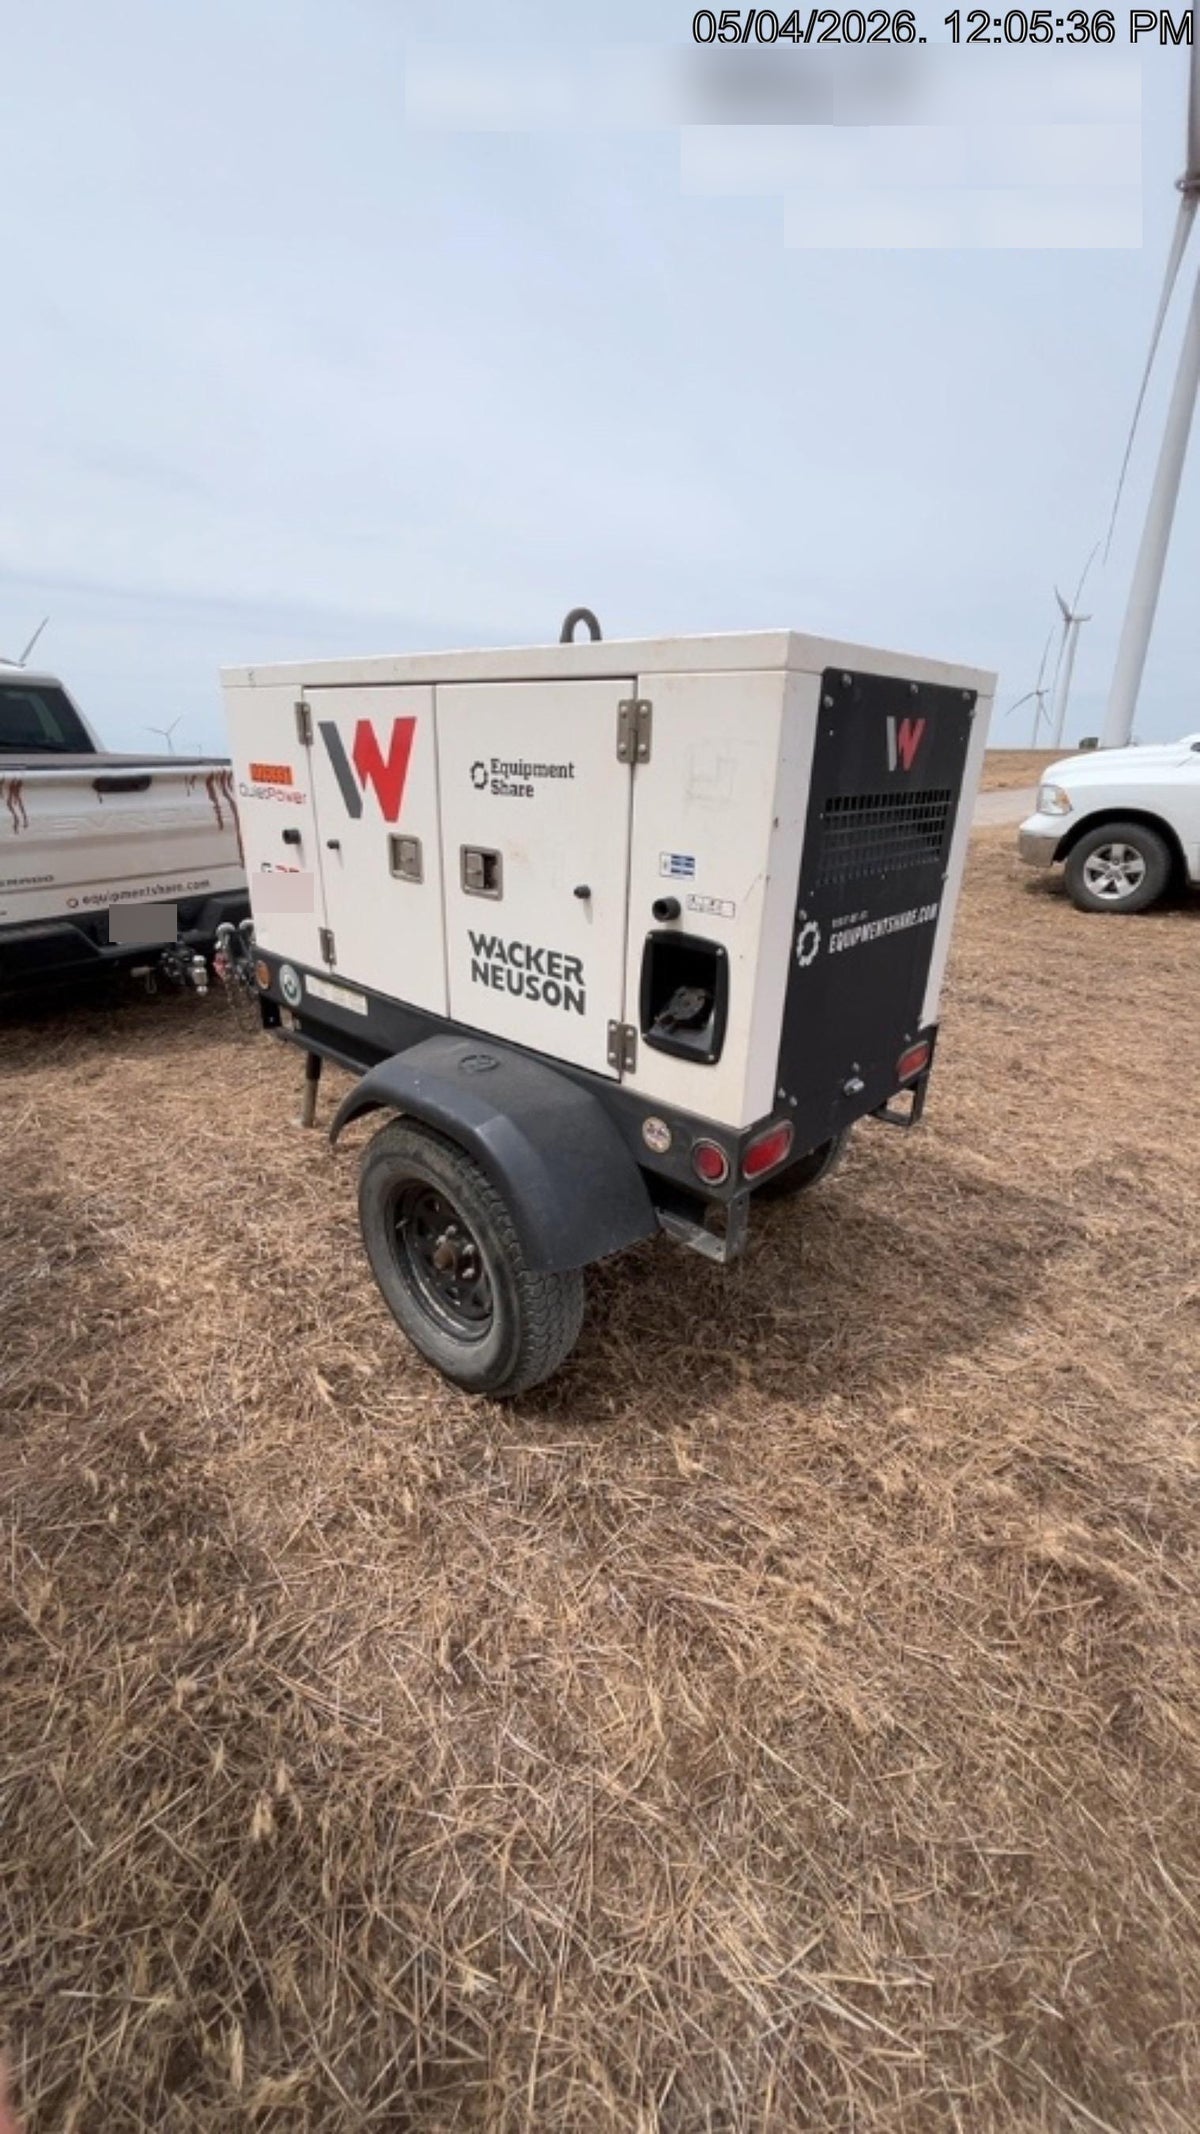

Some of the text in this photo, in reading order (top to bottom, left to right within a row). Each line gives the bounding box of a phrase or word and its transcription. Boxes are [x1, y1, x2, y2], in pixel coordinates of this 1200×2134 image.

[490, 758, 574, 780] Equipment
[490, 779, 534, 797] Share
[467, 929, 585, 986] WACKER
[471, 958, 585, 1015] NEUSON
